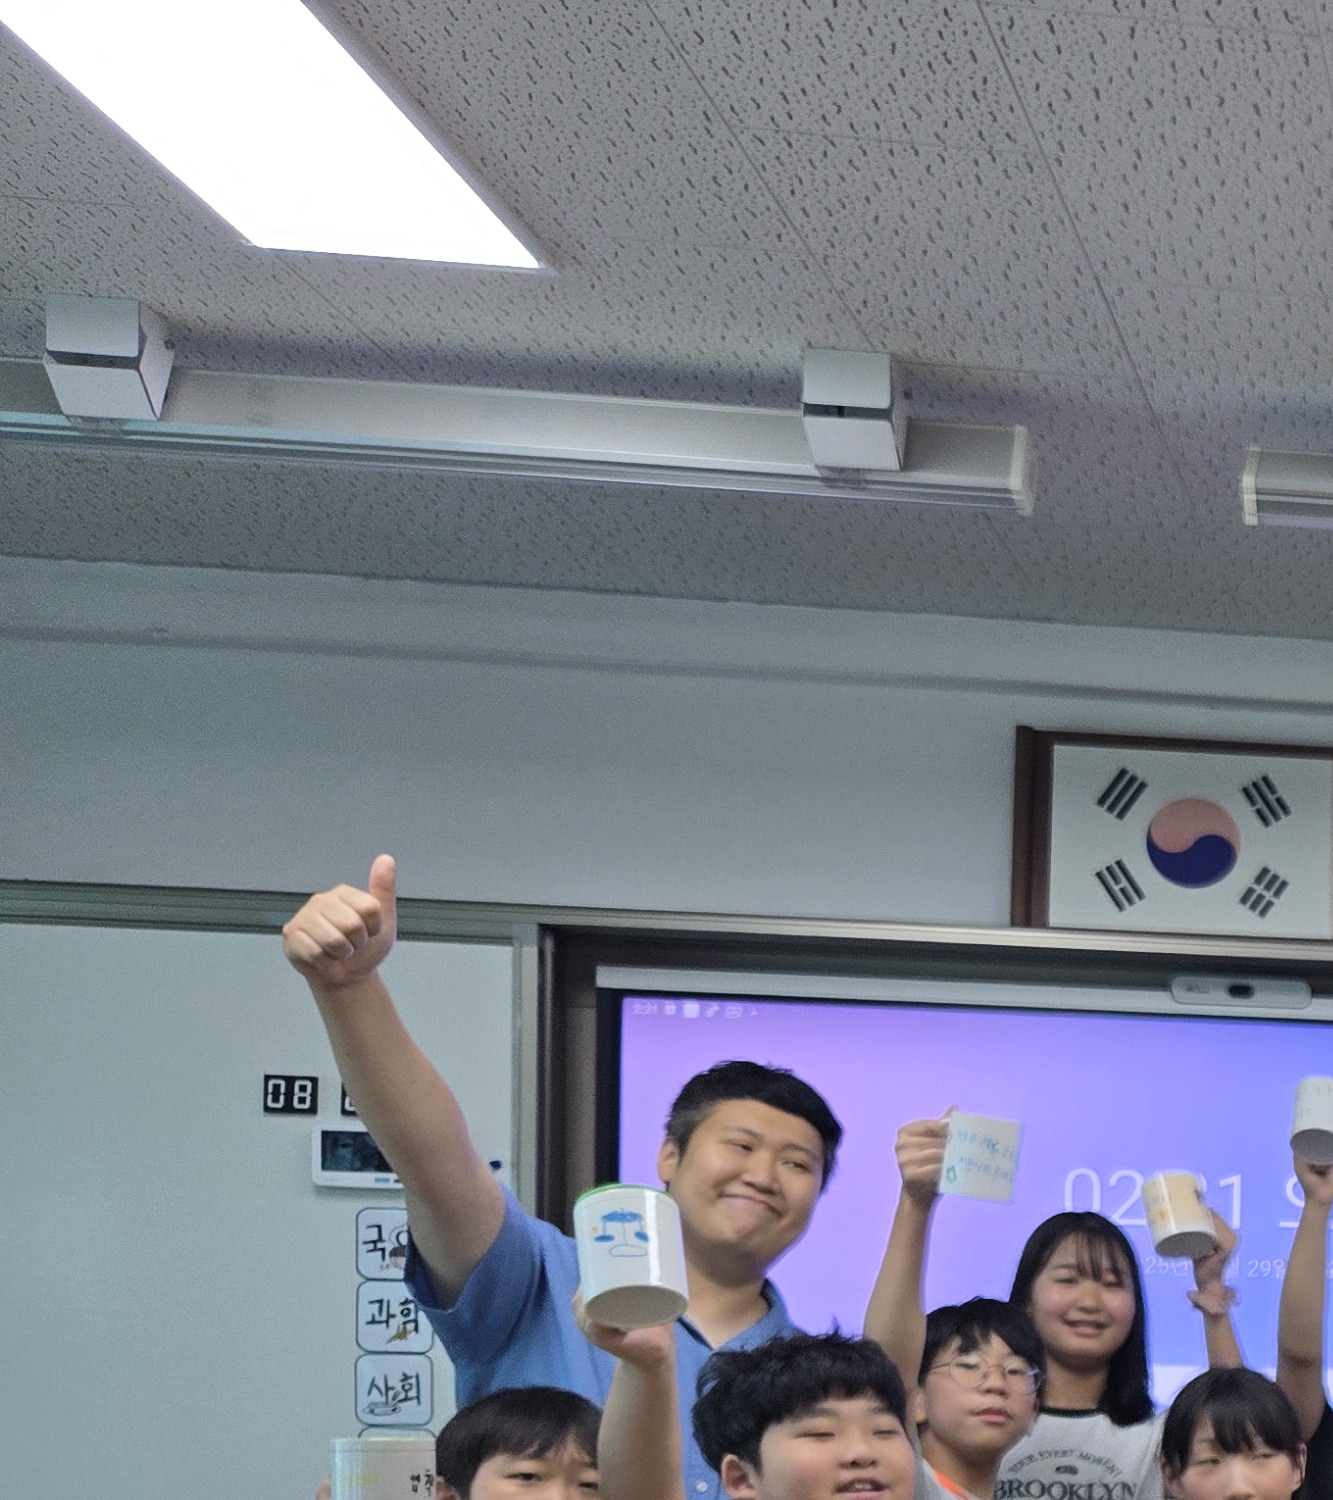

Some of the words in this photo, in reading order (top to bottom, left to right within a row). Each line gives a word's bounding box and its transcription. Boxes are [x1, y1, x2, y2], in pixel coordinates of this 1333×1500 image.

[266, 1079, 313, 1110] 08
[1144, 1256, 1189, 1277] 25년
[365, 1298, 419, 1334] 과학
[366, 1372, 421, 1406] 사회
